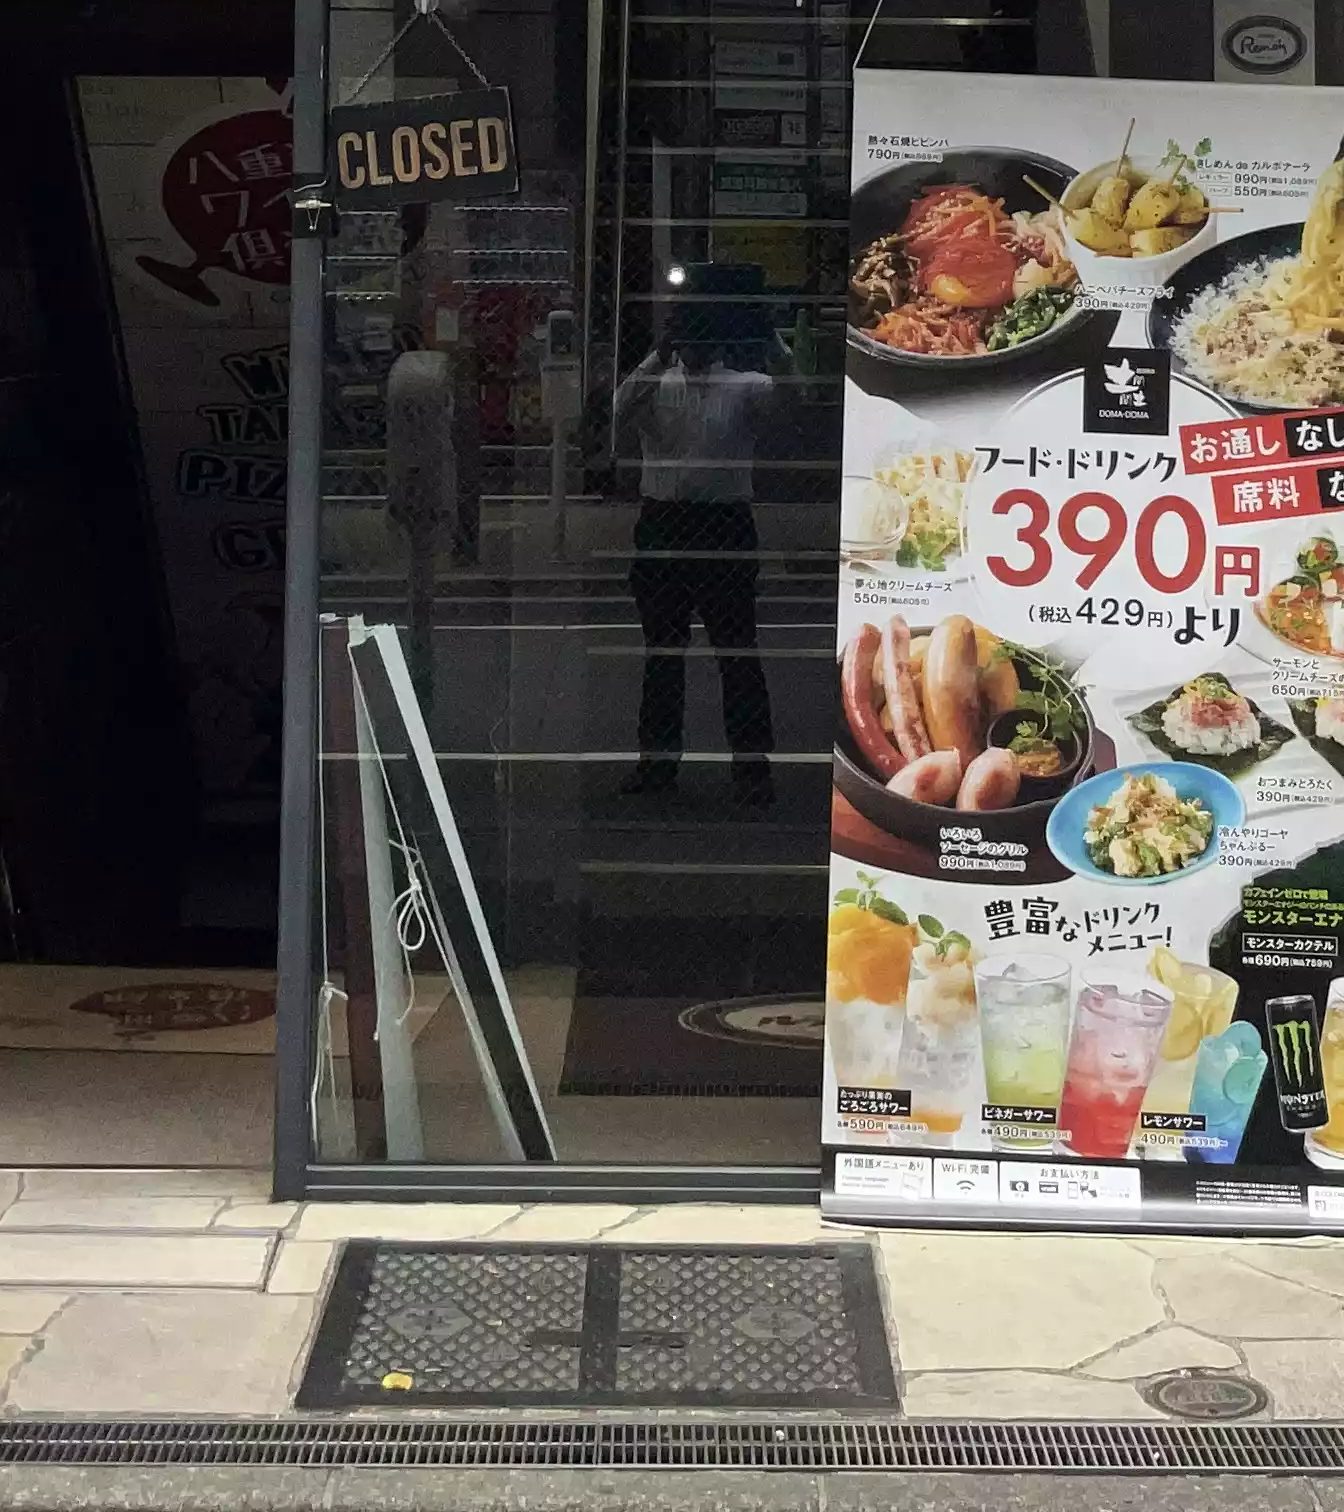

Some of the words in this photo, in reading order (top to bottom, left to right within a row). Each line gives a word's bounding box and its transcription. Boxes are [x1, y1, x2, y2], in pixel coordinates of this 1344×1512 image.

[189, 142, 293, 185] 八重
[338, 117, 507, 189] CLOSED
[197, 403, 288, 444] TA
[1099, 409, 1150, 419] DOMA-DOMA
[1190, 422, 1282, 464] お通し
[179, 449, 286, 503] PIZ
[975, 445, 1177, 484] フード・ドリンク
[1232, 477, 1300, 514] 席料
[986, 488, 1261, 597] 390円
[1173, 607, 1241, 648] より
[1272, 657, 1320, 669] サーモンと
[1258, 776, 1333, 790] おつまみとろたく
[1247, 937, 1334, 951] モンスターカクテル
[840, 1100, 908, 1113] ごろごろサワー
[984, 1106, 1053, 1121] ビネガーサワー
[1143, 1115, 1203, 1129] レモンサワー
[1040, 1168, 1099, 1180] お支払い方法
